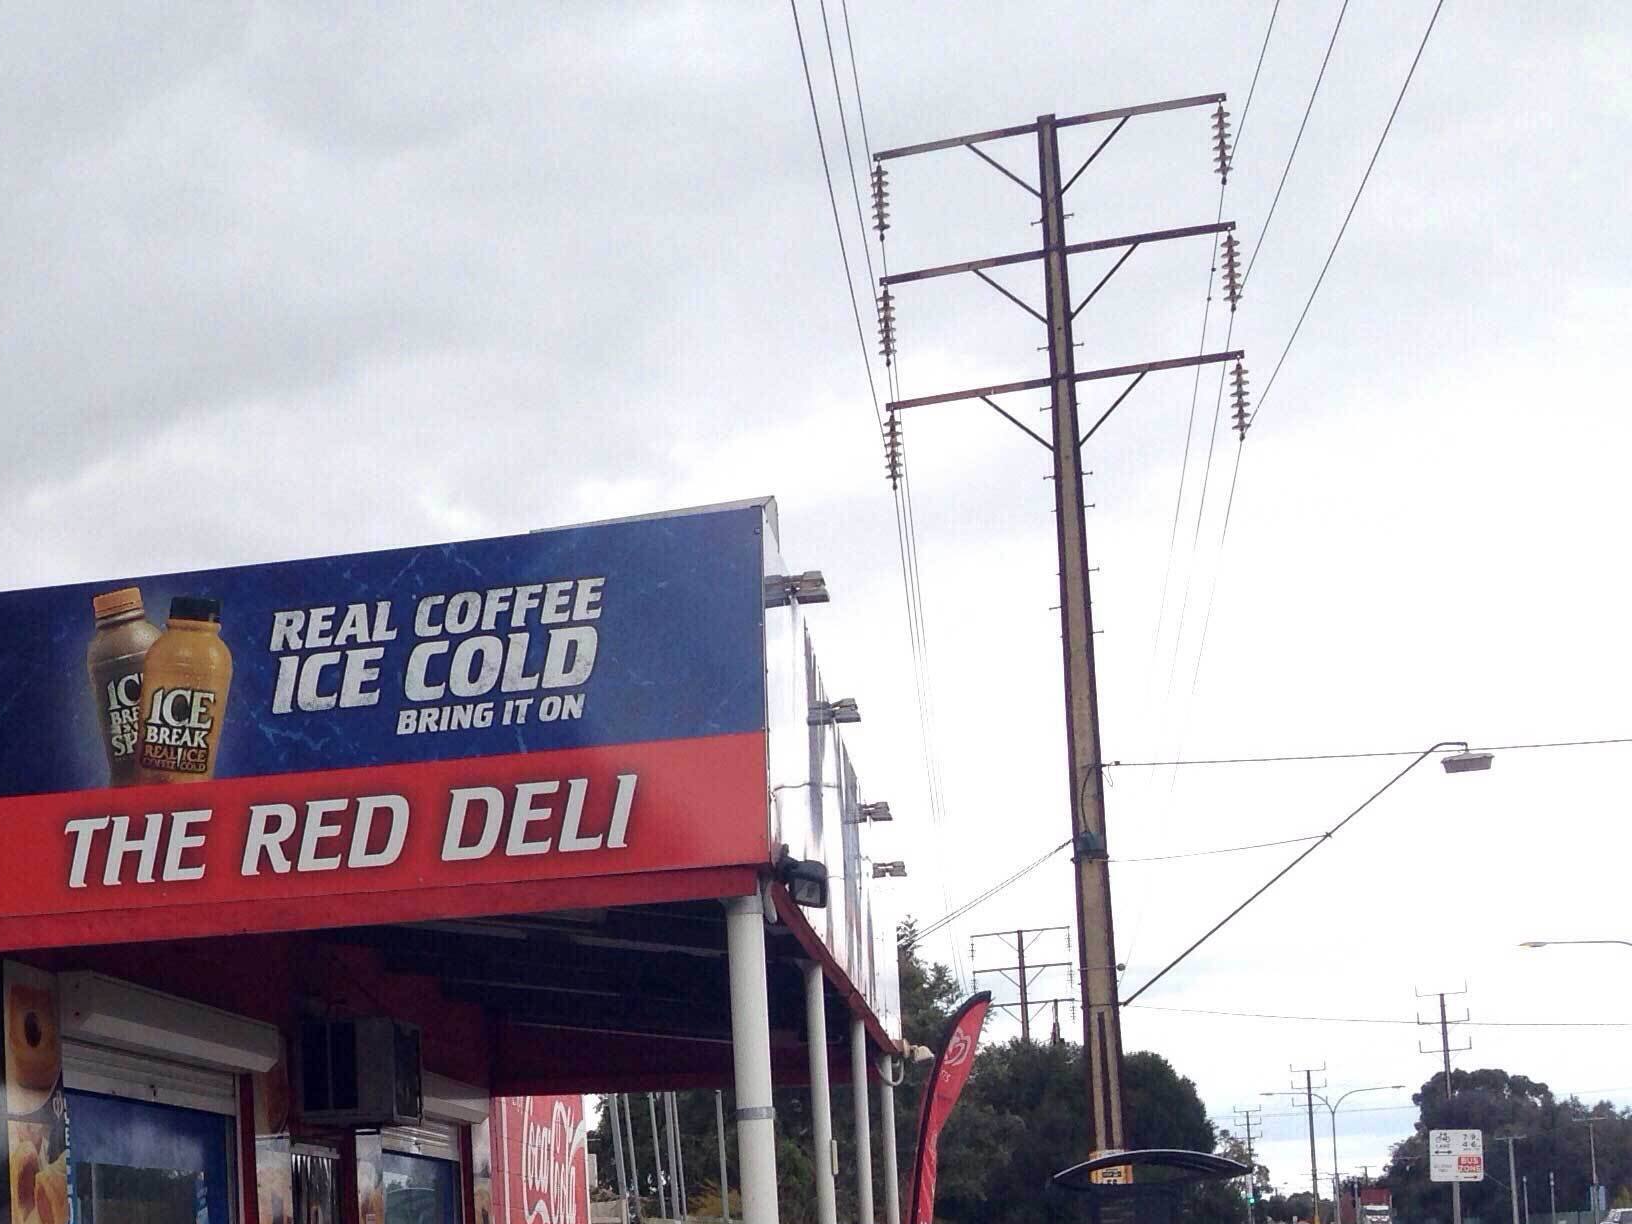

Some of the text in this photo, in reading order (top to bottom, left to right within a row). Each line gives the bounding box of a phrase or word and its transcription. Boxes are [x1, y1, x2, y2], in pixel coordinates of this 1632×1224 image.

[269, 577, 606, 653] REAL COFFEE
[271, 625, 601, 714] ICE COLD
[107, 673, 144, 711] IC
[148, 688, 215, 728] ICE
[396, 693, 585, 736] BRING IT ON
[146, 727, 208, 748] BREAK
[63, 773, 638, 889] THE RED DELI
